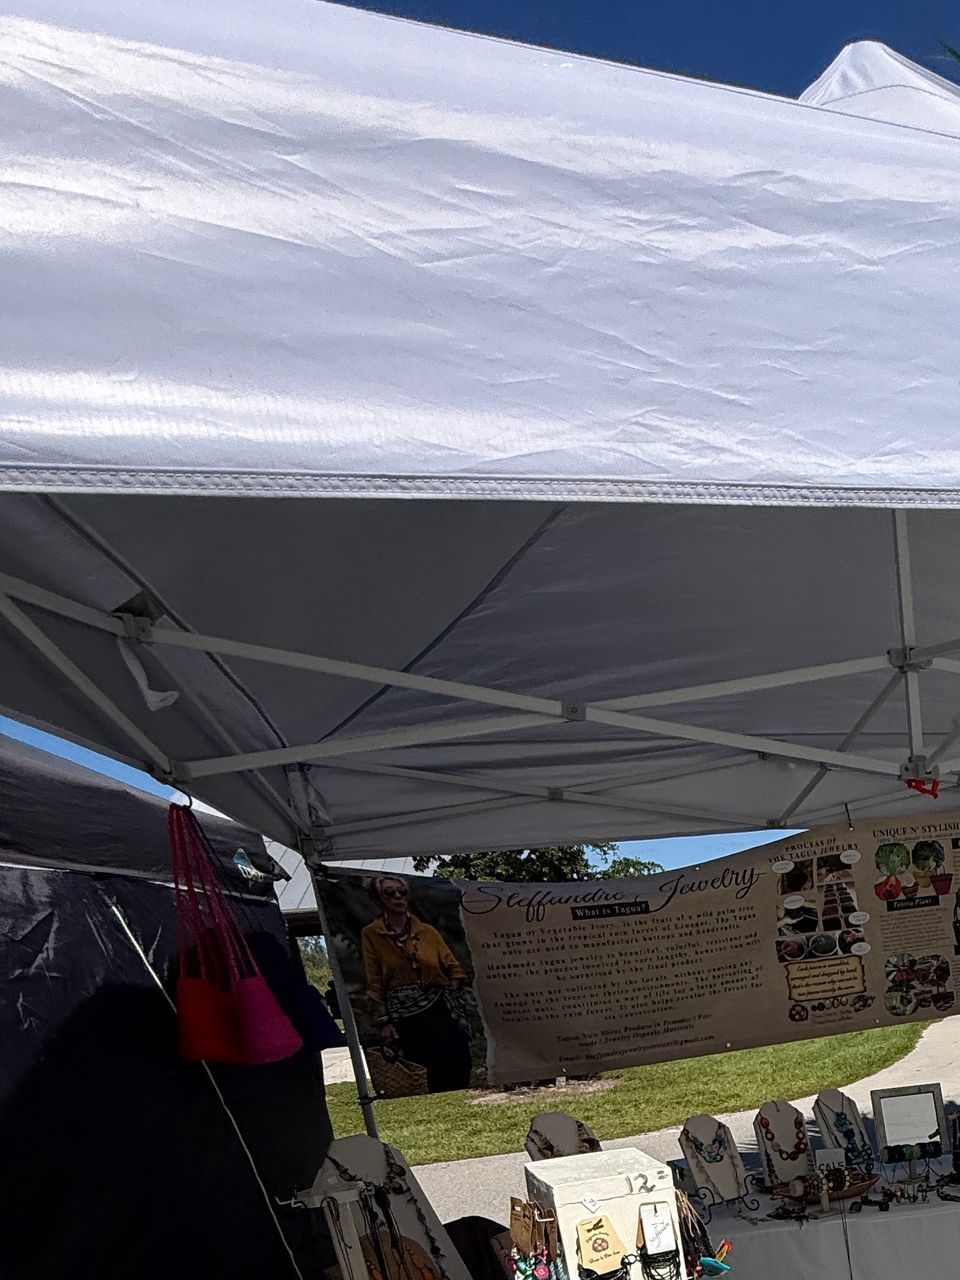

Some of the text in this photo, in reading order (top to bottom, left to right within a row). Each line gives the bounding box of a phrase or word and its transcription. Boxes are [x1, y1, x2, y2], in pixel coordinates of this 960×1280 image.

[872, 827, 908, 839] UNIQUE
[921, 821, 960, 834] STYLISH
[768, 842, 860, 863] THE TAGUA JEWELRY
[785, 836, 837, 853] PROCESS OF
[648, 867, 767, 914] Jewelry
[574, 907, 600, 917] What
[614, 903, 647, 914] Tagua?
[624, 1172, 657, 1194] 12
